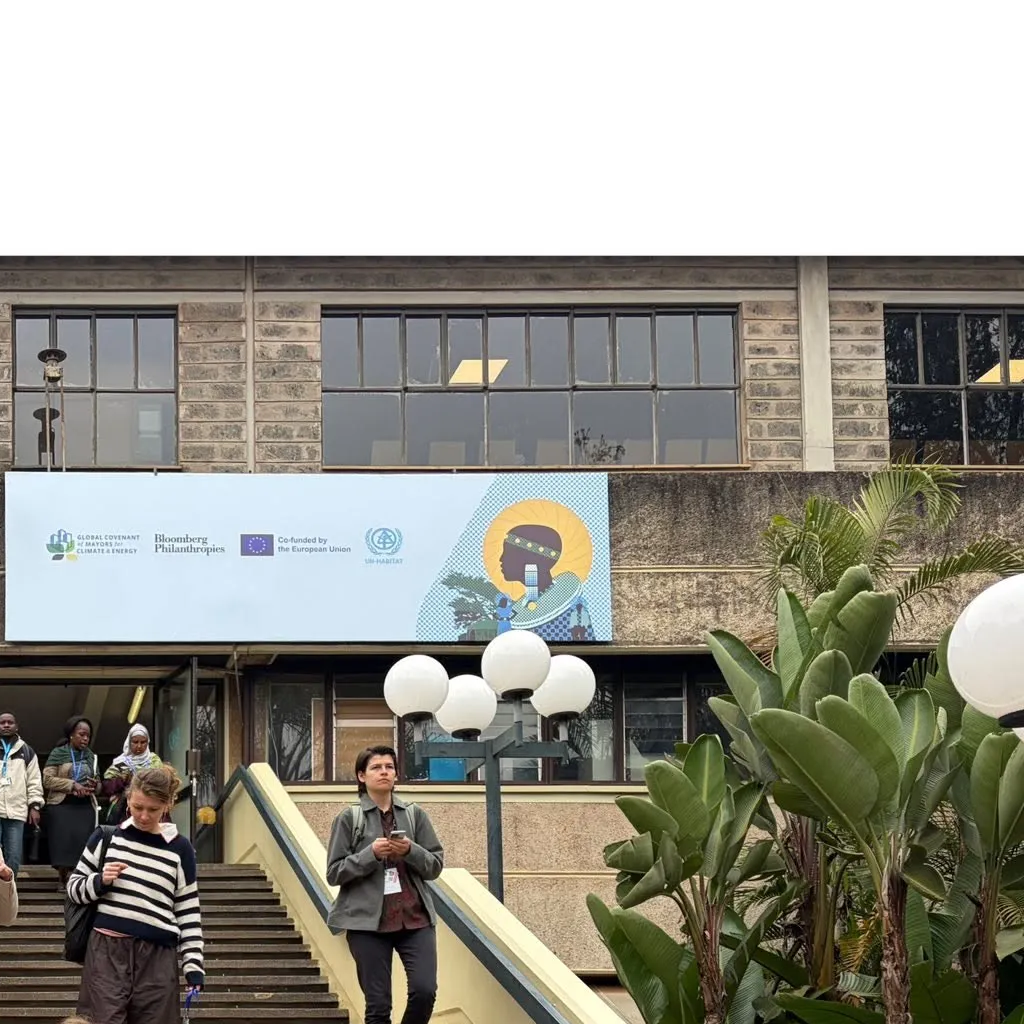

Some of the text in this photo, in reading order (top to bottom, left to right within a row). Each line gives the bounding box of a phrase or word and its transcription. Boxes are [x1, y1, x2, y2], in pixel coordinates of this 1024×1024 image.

[154, 533, 208, 546] Bloomberg
[277, 536, 328, 545] Co-funded by
[154, 543, 226, 556] Philanthropies
[291, 545, 327, 554] European
